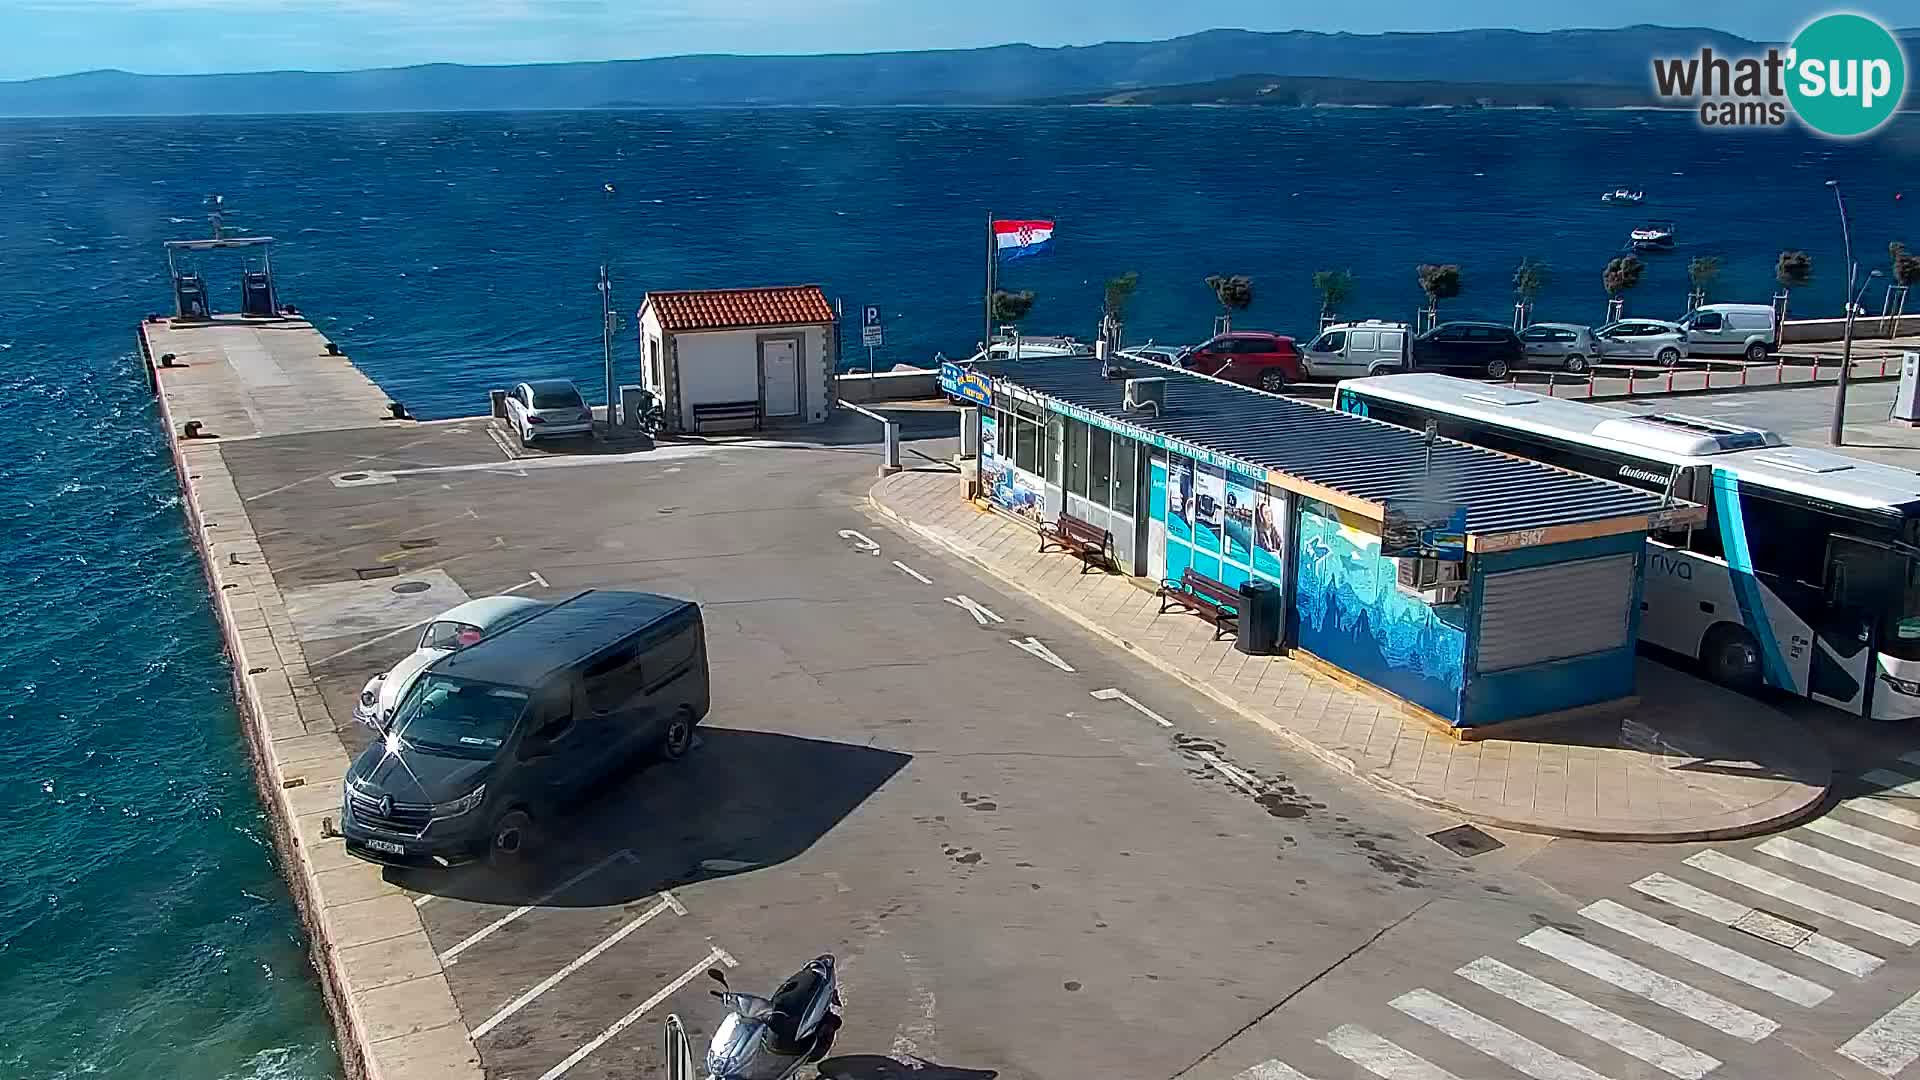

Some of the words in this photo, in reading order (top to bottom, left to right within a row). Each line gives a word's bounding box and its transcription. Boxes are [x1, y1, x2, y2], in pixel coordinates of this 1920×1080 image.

[867, 307, 877, 324] P
[1127, 425, 1155, 444] POSTAJA
[1165, 438, 1178, 451] BUS
[1179, 443, 1209, 462] STATION
[1211, 453, 1235, 469] TICKET
[1237, 462, 1263, 478] OFFICE
[1618, 464, 1669, 486] Autotrans
[1652, 553, 1692, 580] riva
